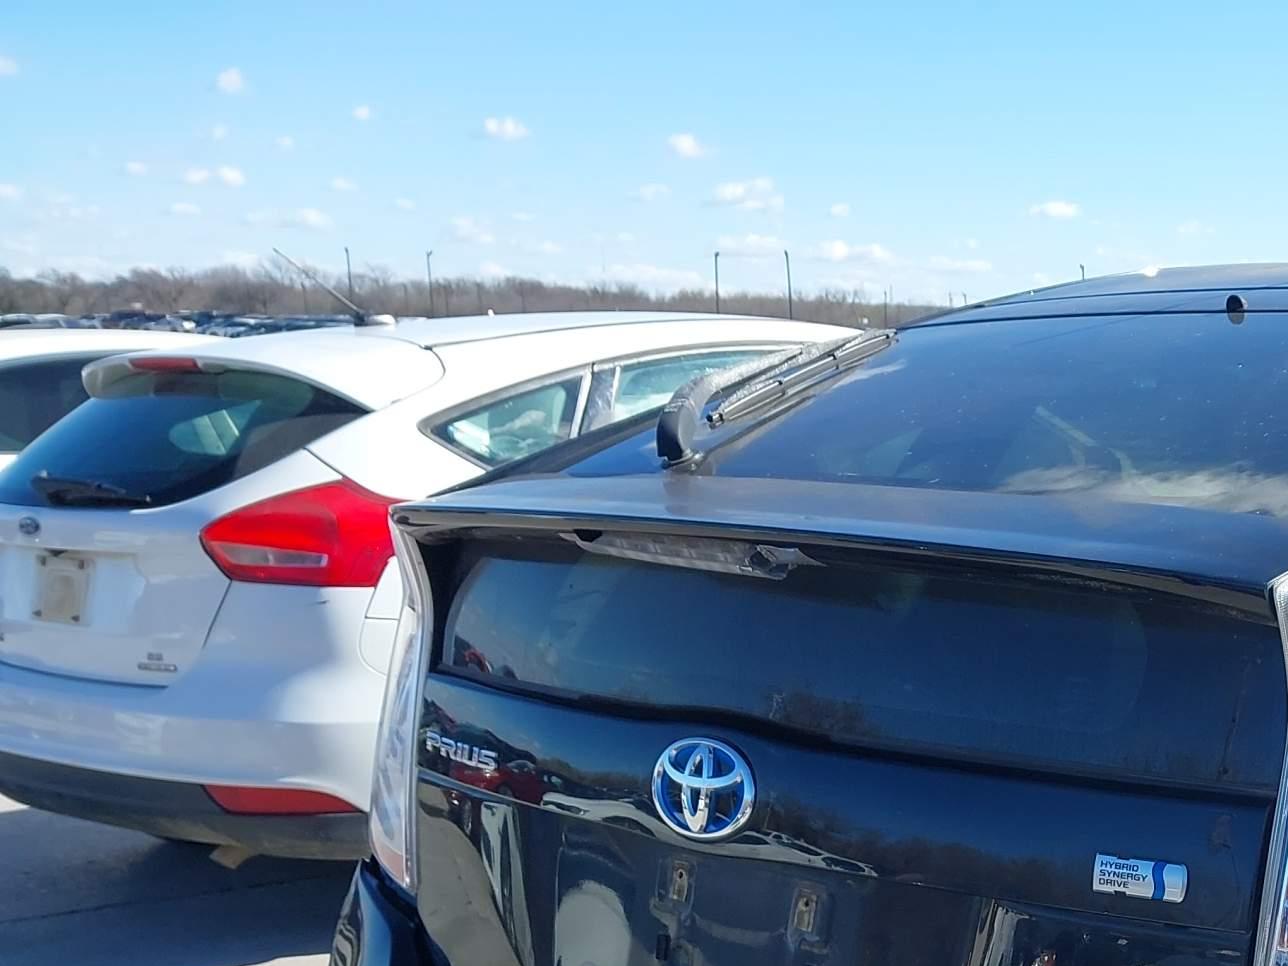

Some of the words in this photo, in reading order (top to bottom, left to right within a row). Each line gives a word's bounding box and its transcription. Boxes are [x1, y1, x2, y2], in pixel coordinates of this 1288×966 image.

[426, 731, 498, 771] PRIUS
[1100, 861, 1139, 872] HYBRID
[1099, 870, 1148, 882] SYNERGY
[1098, 878, 1129, 889] DRIVE
